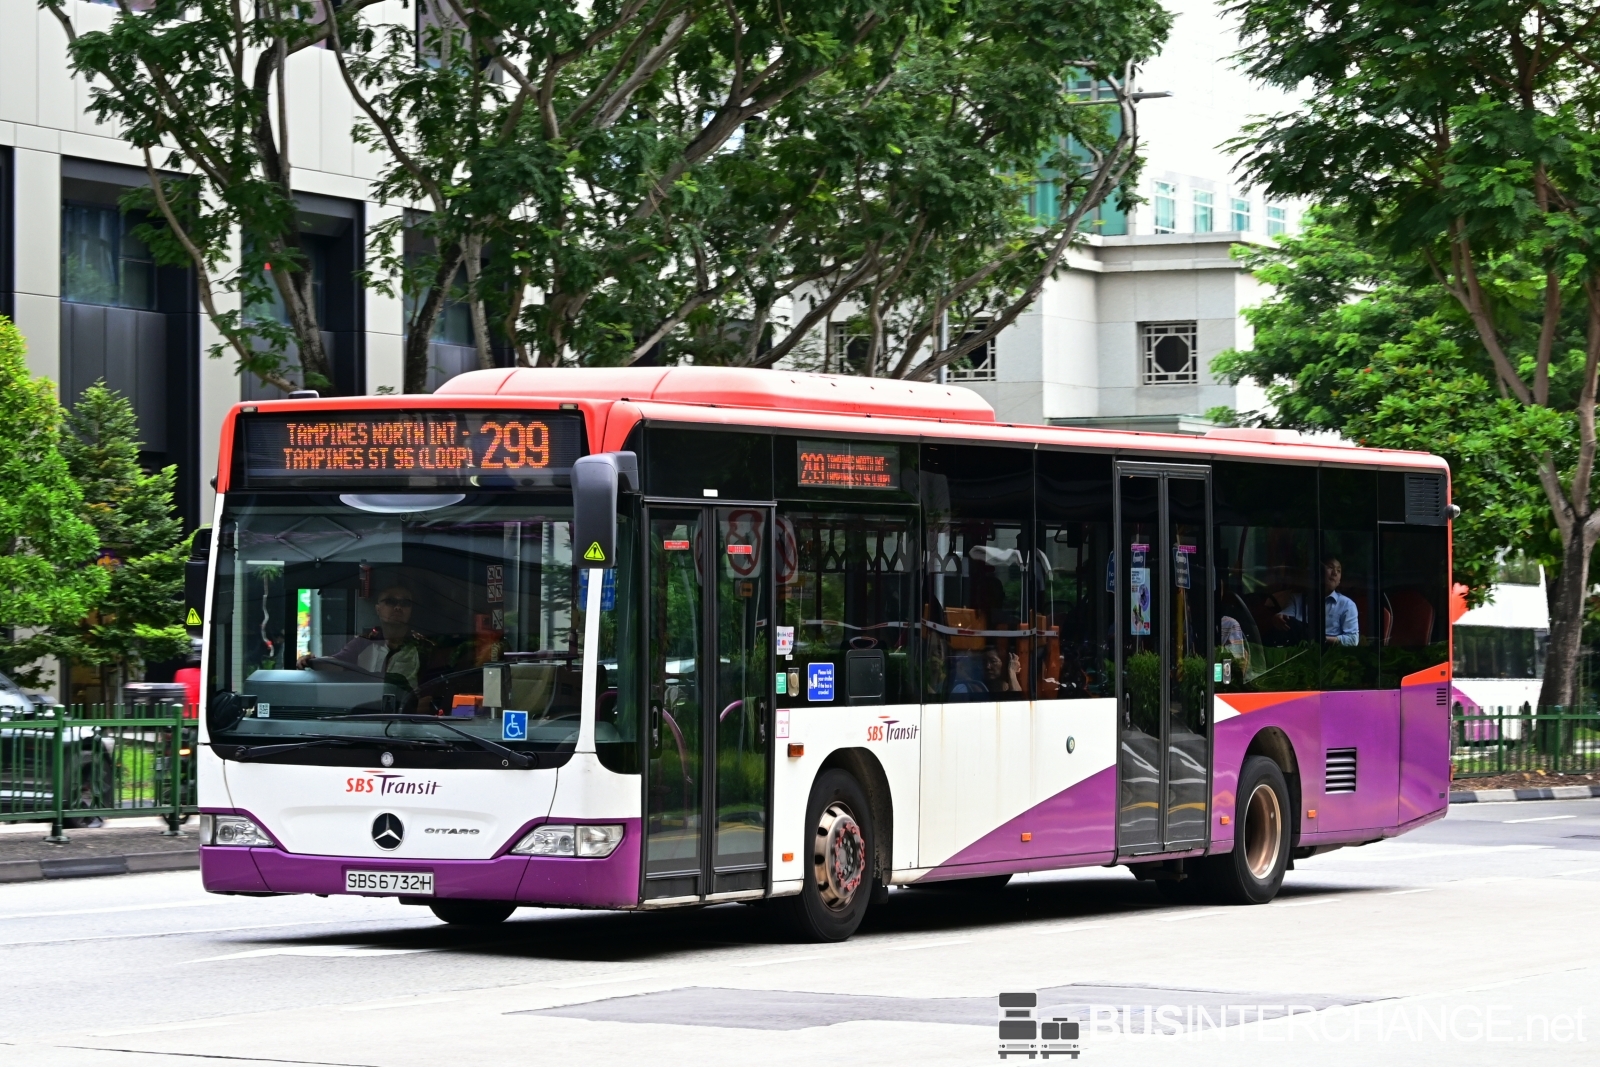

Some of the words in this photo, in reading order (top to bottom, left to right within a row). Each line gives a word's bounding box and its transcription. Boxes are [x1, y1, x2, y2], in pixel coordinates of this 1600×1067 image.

[286, 422, 368, 446] TAMPINES
[372, 422, 425, 446] NORTH
[428, 421, 457, 445] INT
[480, 421, 549, 469] 299
[283, 447, 365, 470] TAMPINES
[368, 448, 389, 469] ST
[393, 448, 415, 469] 96
[418, 447, 474, 469] (LOOP)
[866, 725, 884, 742] SBS
[882, 720, 920, 744] Transit
[346, 778, 374, 793] SBS
[373, 774, 443, 796] Transit
[424, 827, 480, 835] CITARO
[347, 873, 432, 891] SBS6732H
